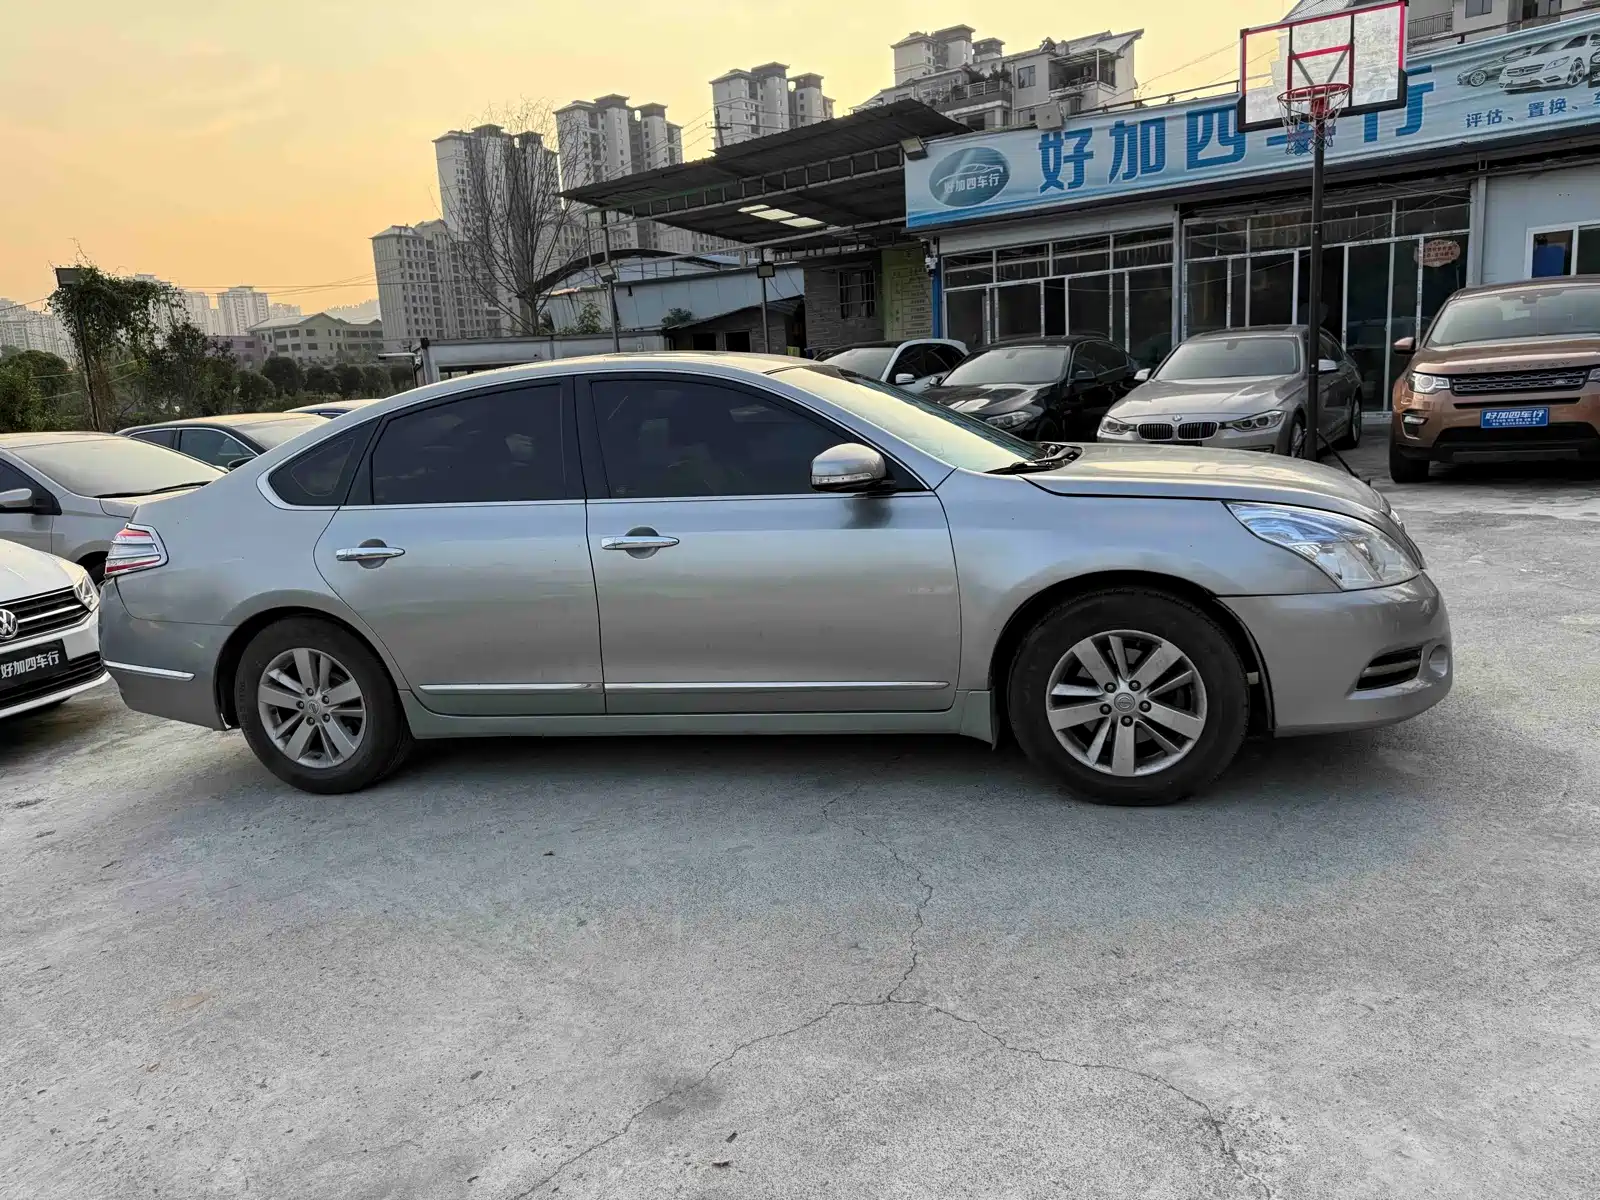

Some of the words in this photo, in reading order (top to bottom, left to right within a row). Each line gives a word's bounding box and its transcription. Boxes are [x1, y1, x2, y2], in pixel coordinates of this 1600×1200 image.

[944, 173, 1000, 194] 好加四车行
[1485, 409, 1545, 420] 好加四车行
[0, 650, 60, 679] 好加四车行
